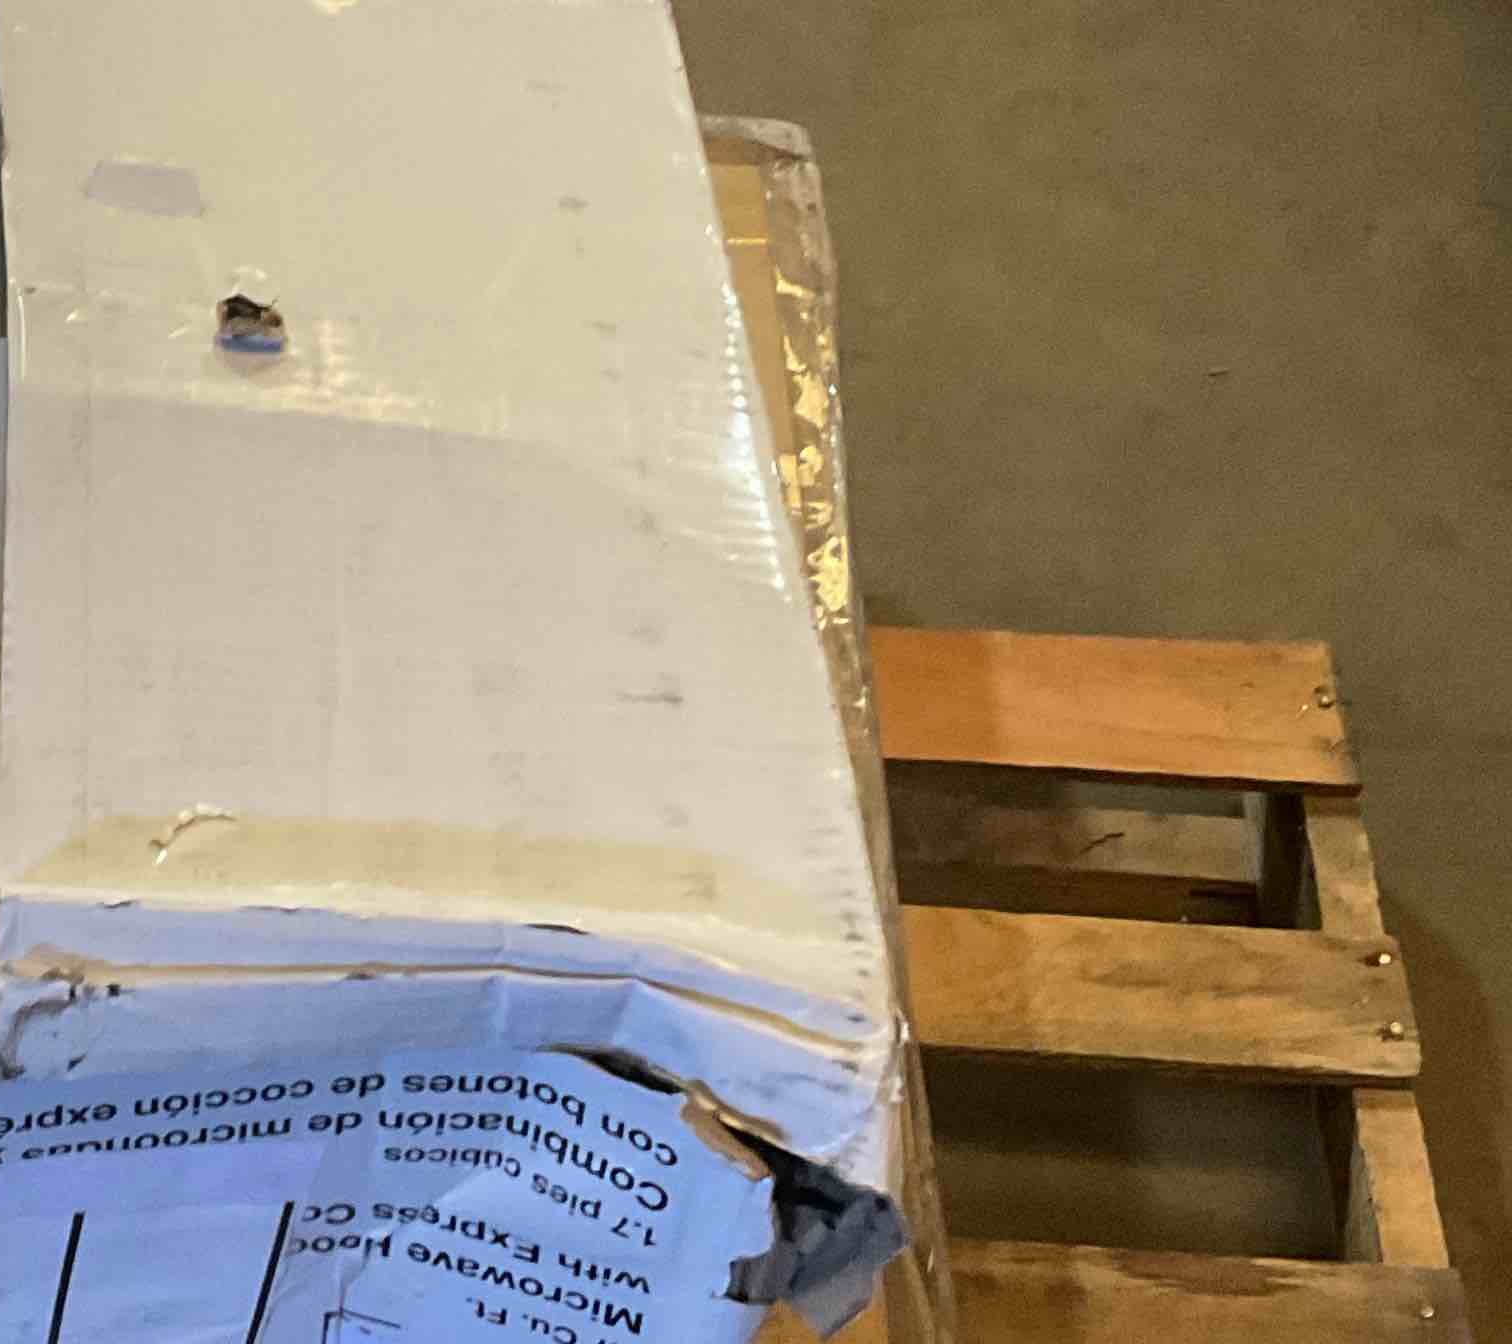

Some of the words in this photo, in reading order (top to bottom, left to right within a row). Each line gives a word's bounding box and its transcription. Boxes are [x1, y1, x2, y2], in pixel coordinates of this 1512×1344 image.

[133, 1079, 316, 1124] cocción
[330, 1073, 386, 1100] de
[401, 1074, 588, 1127] botones
[307, 1112, 364, 1136] de
[600, 1113, 679, 1167] con
[376, 1109, 670, 1213] Combinación
[383, 1146, 522, 1181] cúbicos
[531, 1173, 603, 1221] pies
[372, 1203, 543, 1265] Express
[610, 1214, 658, 1248] 1.7
[406, 1241, 644, 1336] Microwave
[556, 1252, 651, 1295] with
[465, 1296, 510, 1328] Ft.
